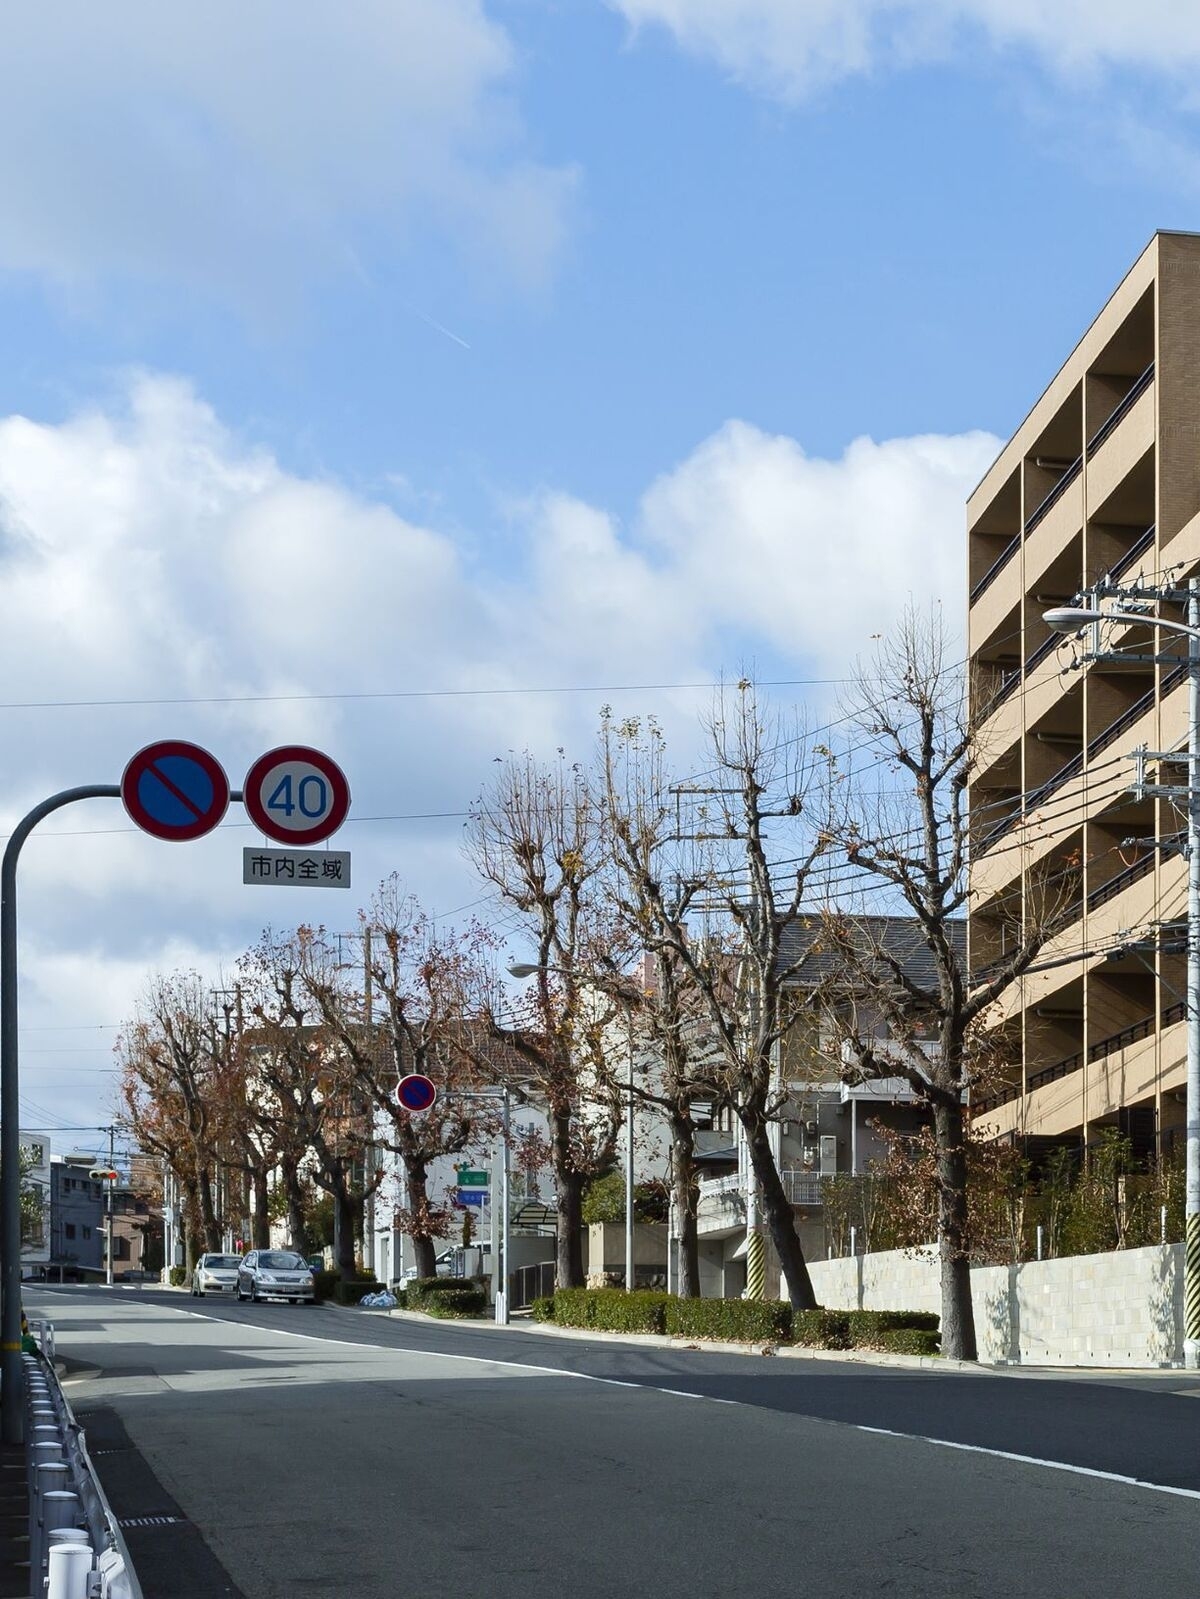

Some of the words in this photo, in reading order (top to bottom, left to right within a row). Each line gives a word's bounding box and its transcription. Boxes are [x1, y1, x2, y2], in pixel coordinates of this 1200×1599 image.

[267, 774, 327, 818] 40
[251, 855, 342, 880] 市内全域
